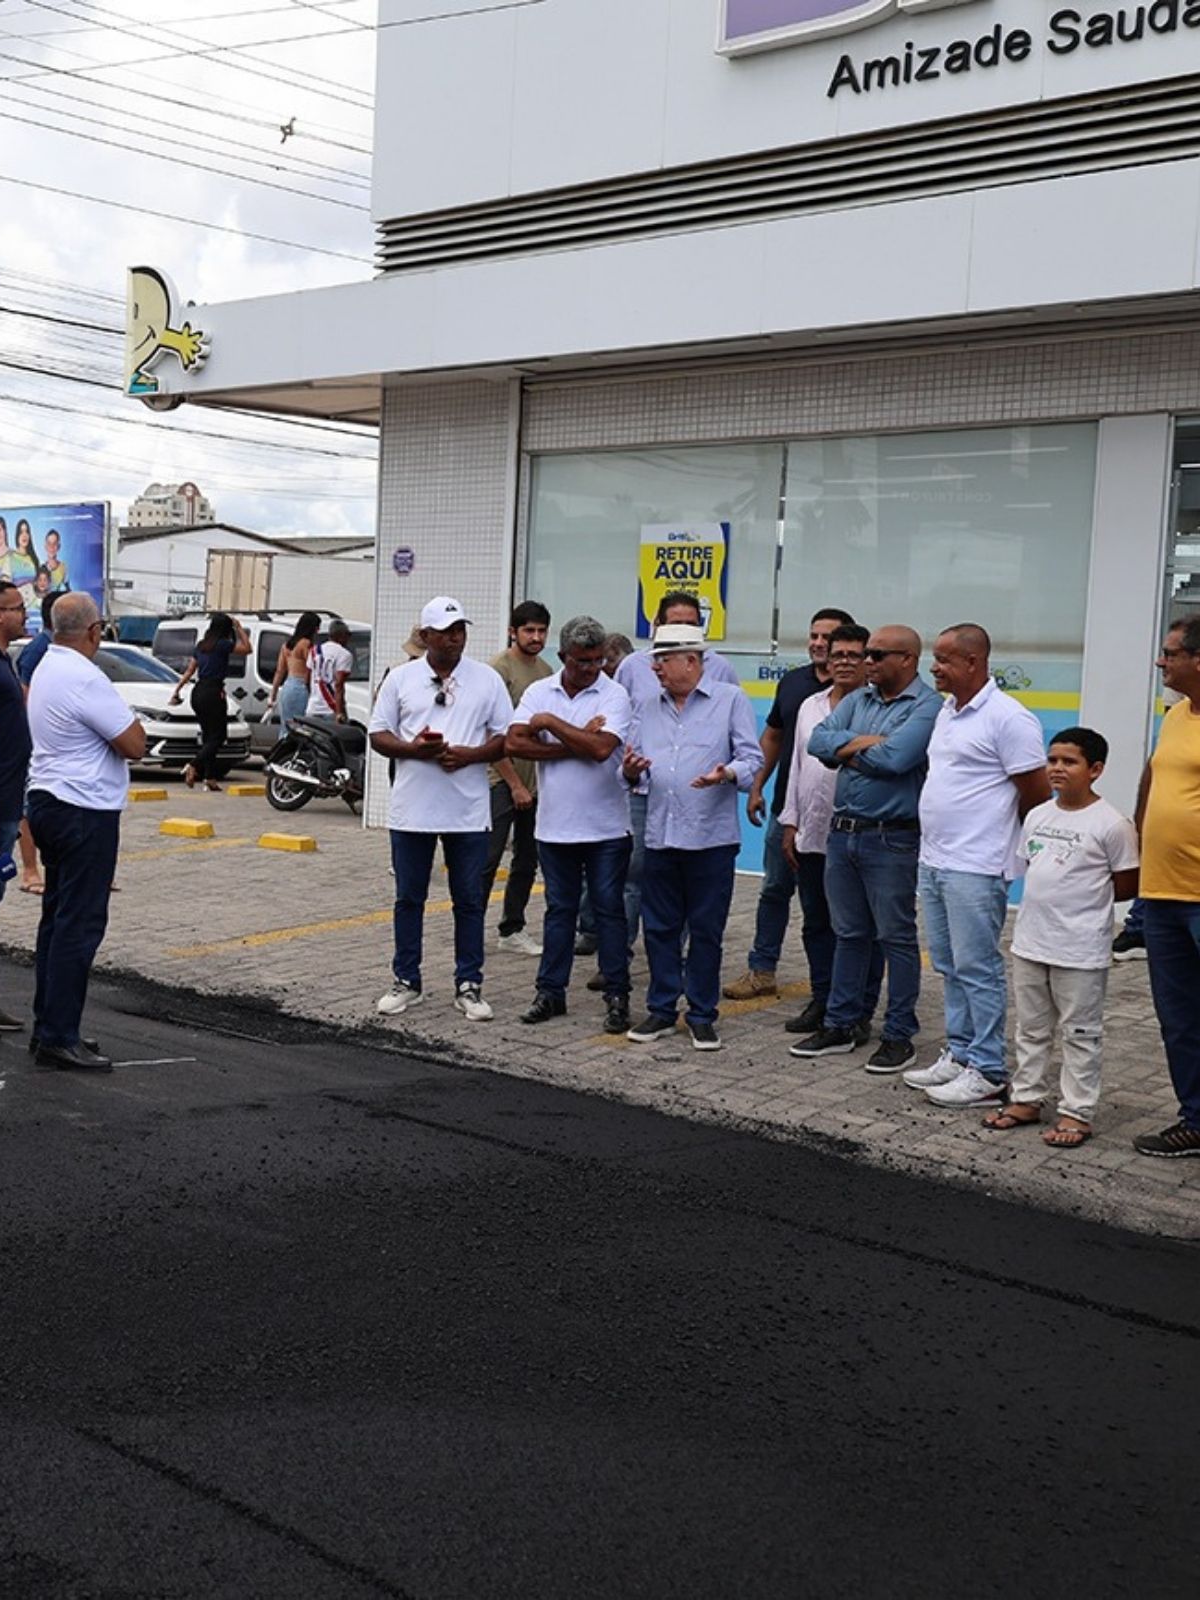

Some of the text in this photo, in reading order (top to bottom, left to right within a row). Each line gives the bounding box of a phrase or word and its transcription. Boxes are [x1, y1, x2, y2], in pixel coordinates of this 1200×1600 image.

[827, 23, 1032, 99] Amizade
[655, 546, 714, 561] RETIRE
[654, 561, 713, 580] AQUI
